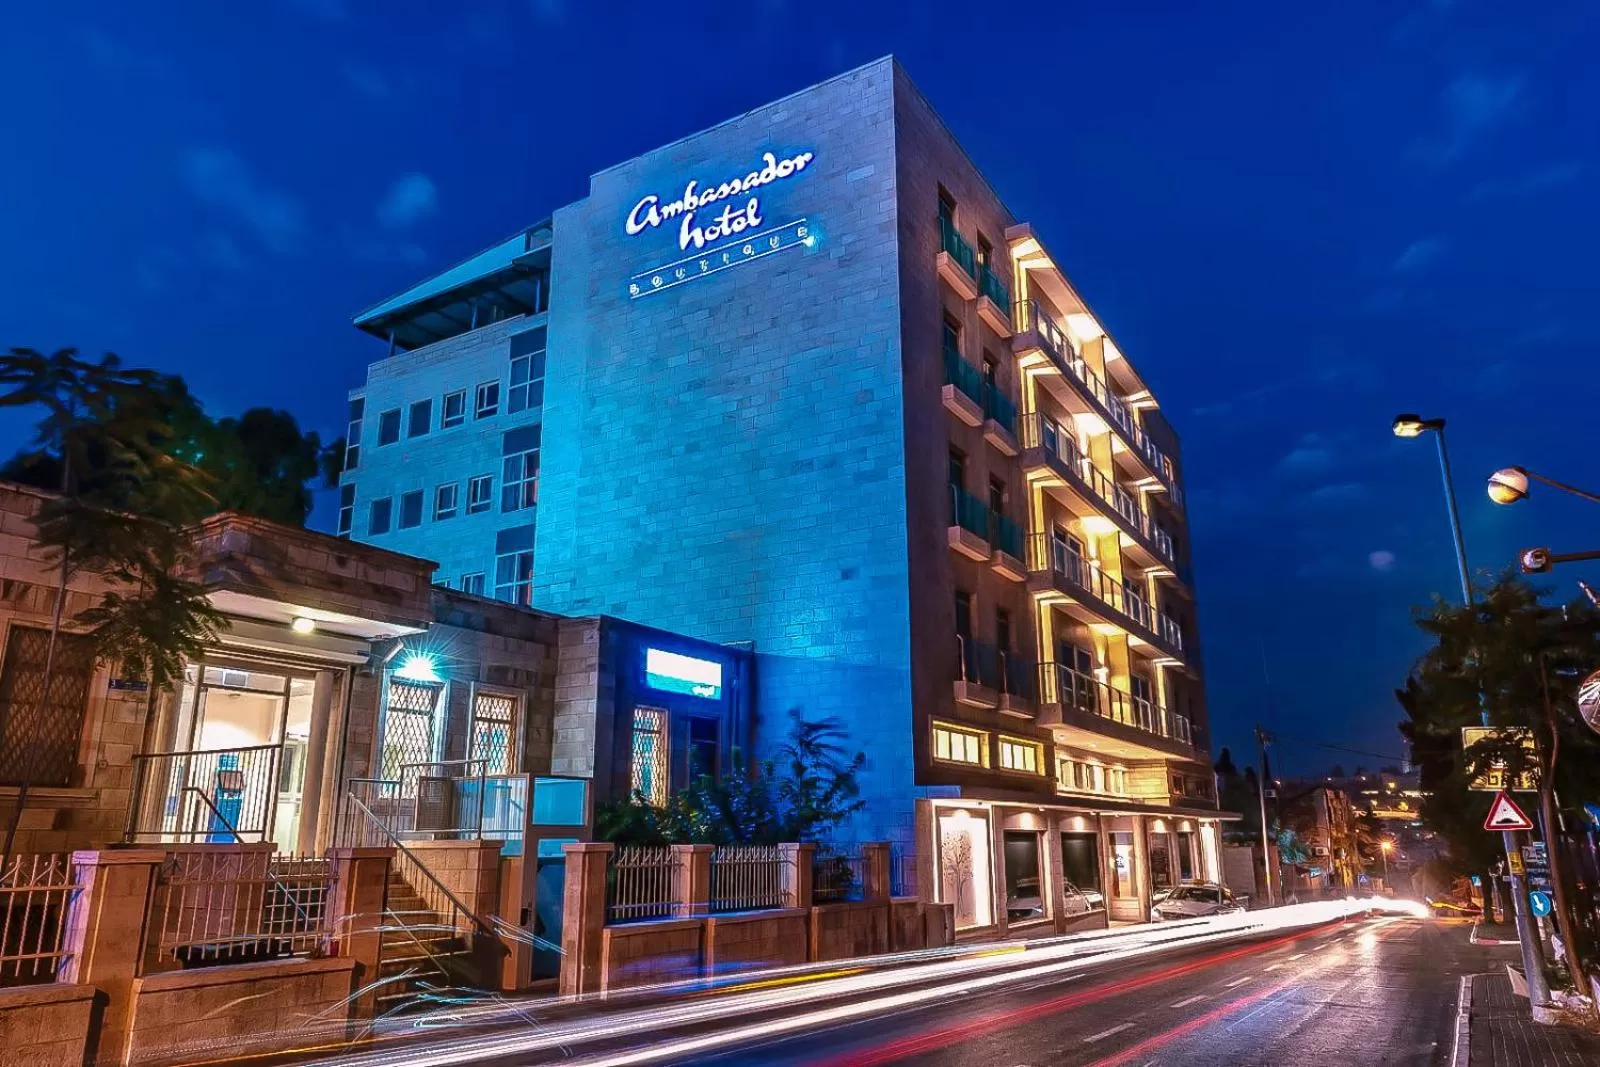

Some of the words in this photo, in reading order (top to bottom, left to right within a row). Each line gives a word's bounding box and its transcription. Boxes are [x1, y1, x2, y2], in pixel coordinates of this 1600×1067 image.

[626, 152, 813, 236] Ambassador
[679, 198, 763, 250] hotel
[629, 226, 808, 295] BOUTIQUE
